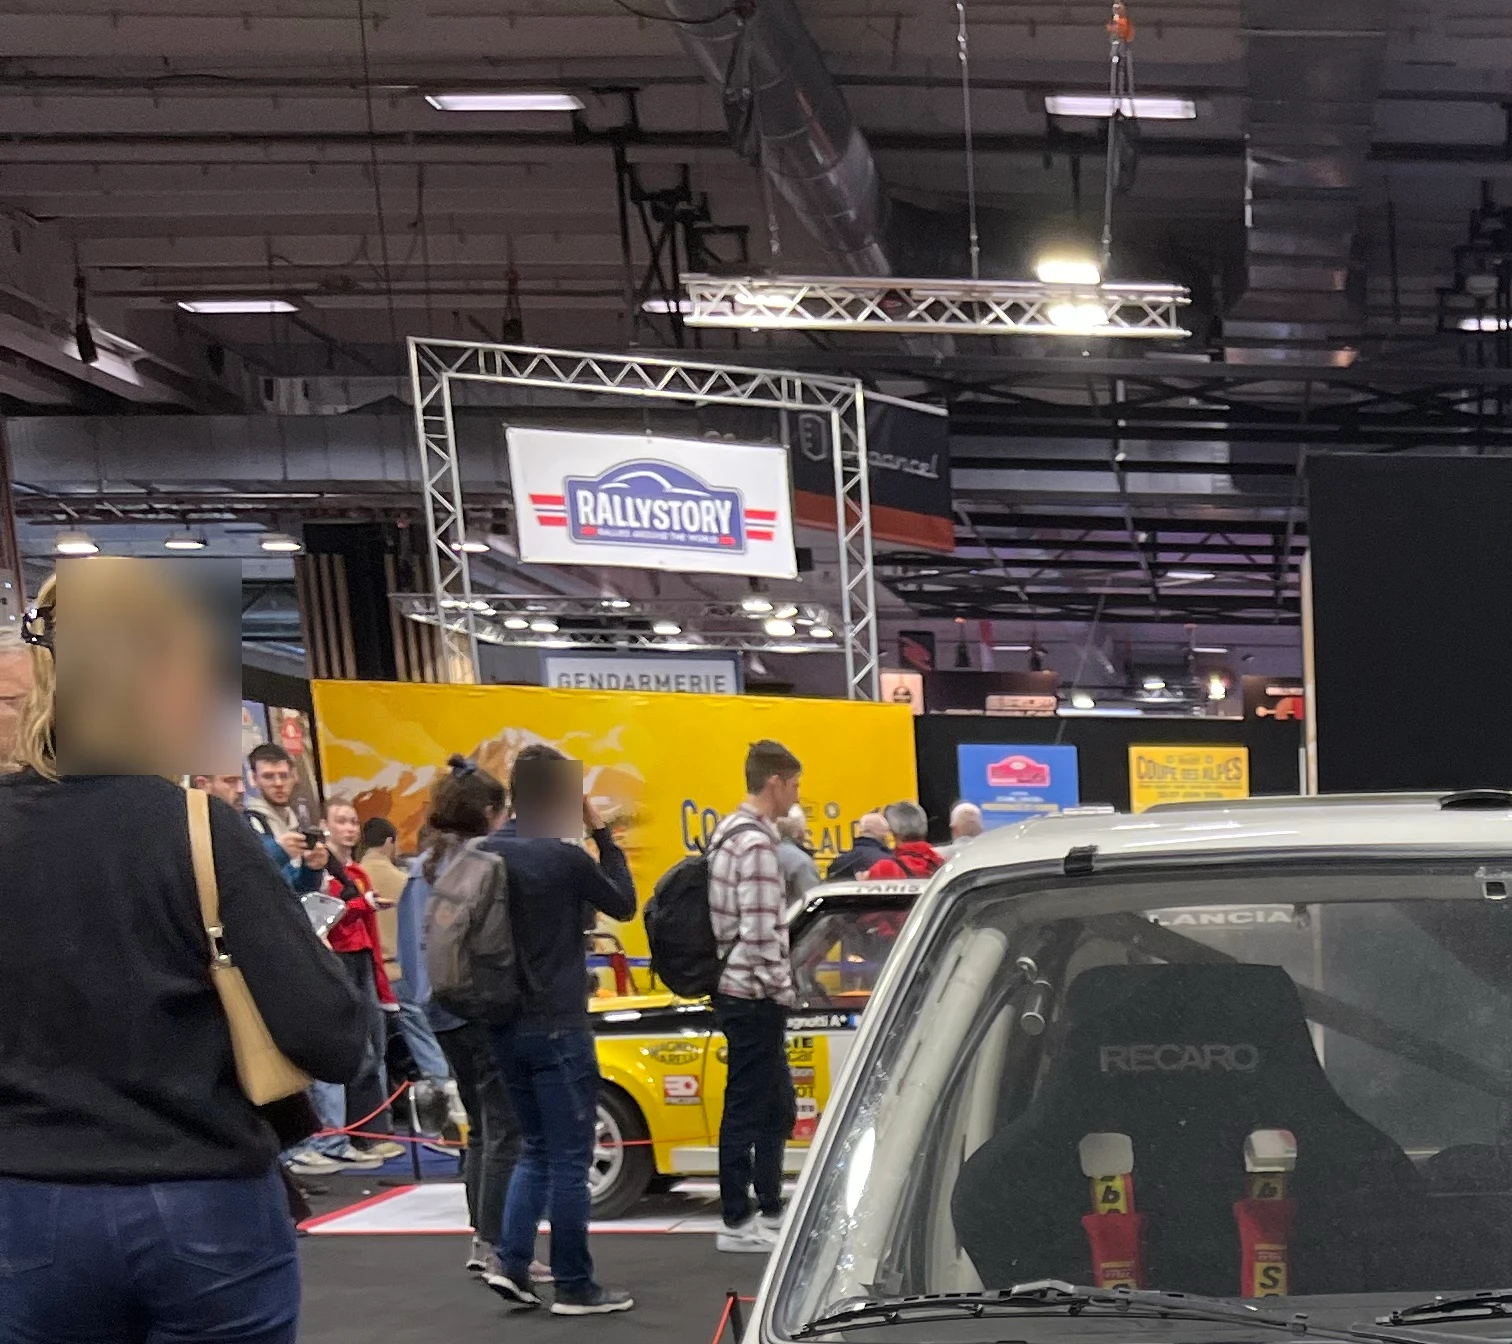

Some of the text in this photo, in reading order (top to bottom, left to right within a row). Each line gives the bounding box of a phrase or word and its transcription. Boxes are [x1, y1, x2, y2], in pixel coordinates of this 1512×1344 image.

[575, 488, 732, 535] RALLYSTORY
[557, 671, 727, 694] GENDARMERIE
[1149, 910, 1292, 926] LANCIA
[1100, 1043, 1260, 1073] RECARO
